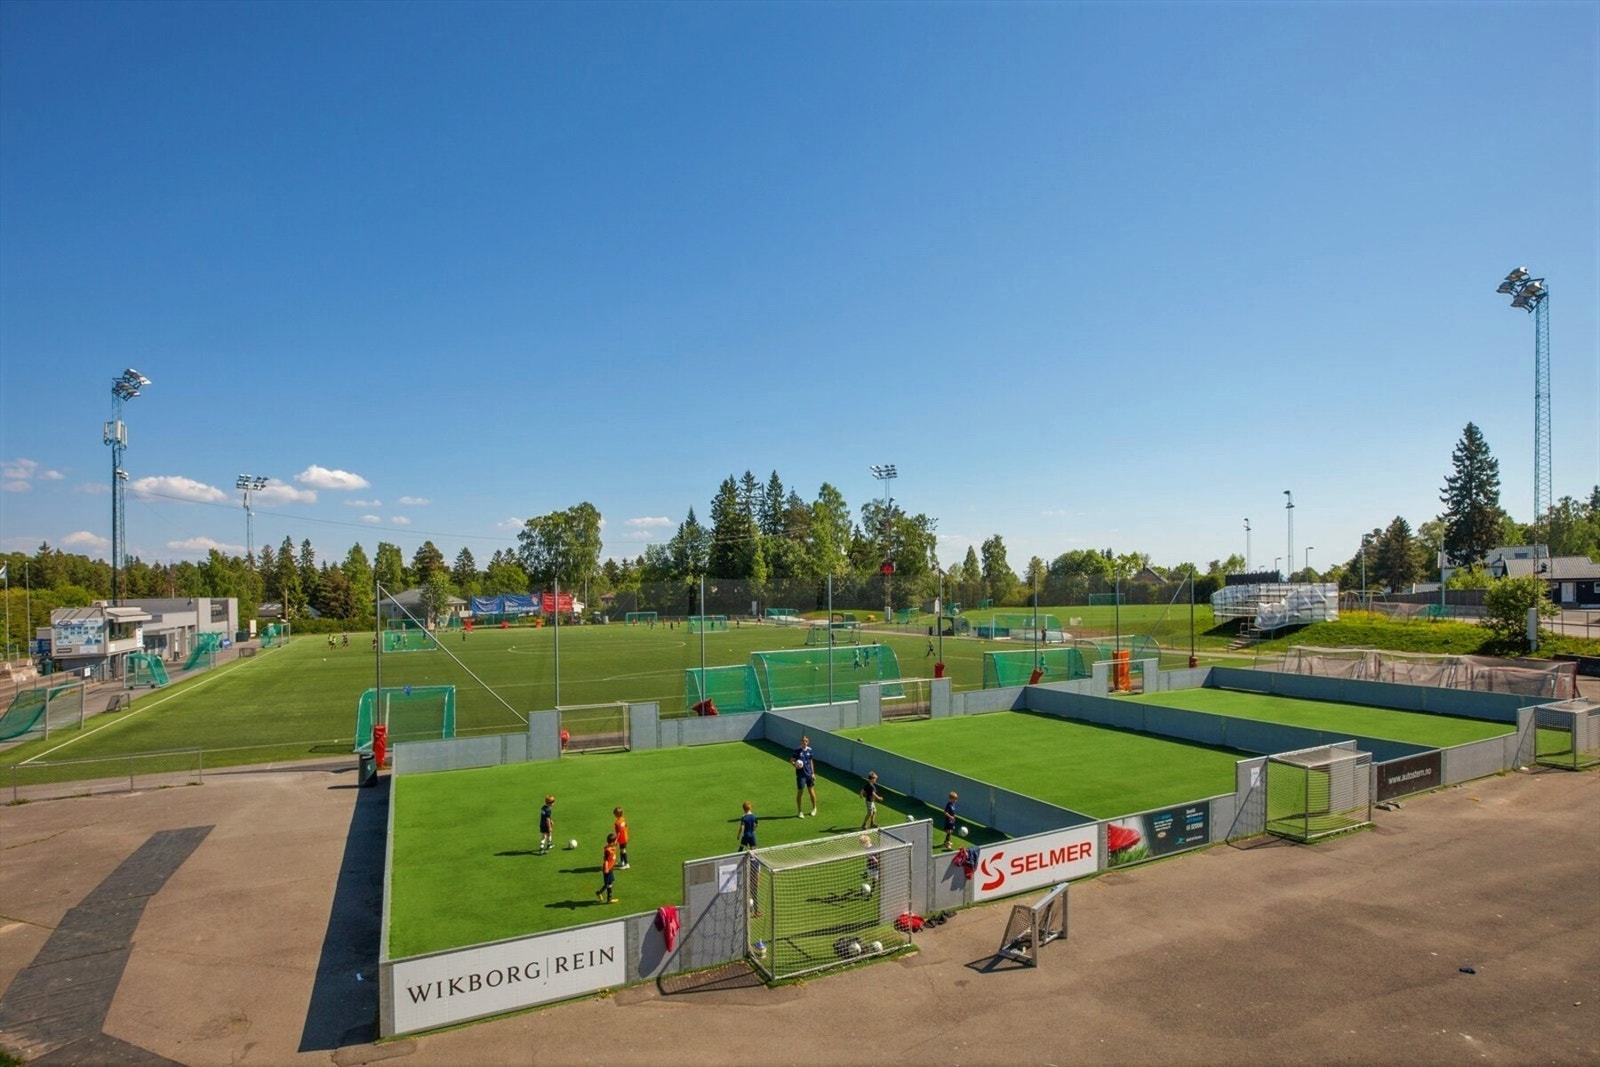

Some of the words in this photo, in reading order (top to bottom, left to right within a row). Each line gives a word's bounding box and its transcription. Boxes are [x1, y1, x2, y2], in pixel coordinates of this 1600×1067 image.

[1010, 842, 1092, 876] SELMER
[407, 961, 541, 1004] WIKBORG
[555, 946, 615, 974] REIN
